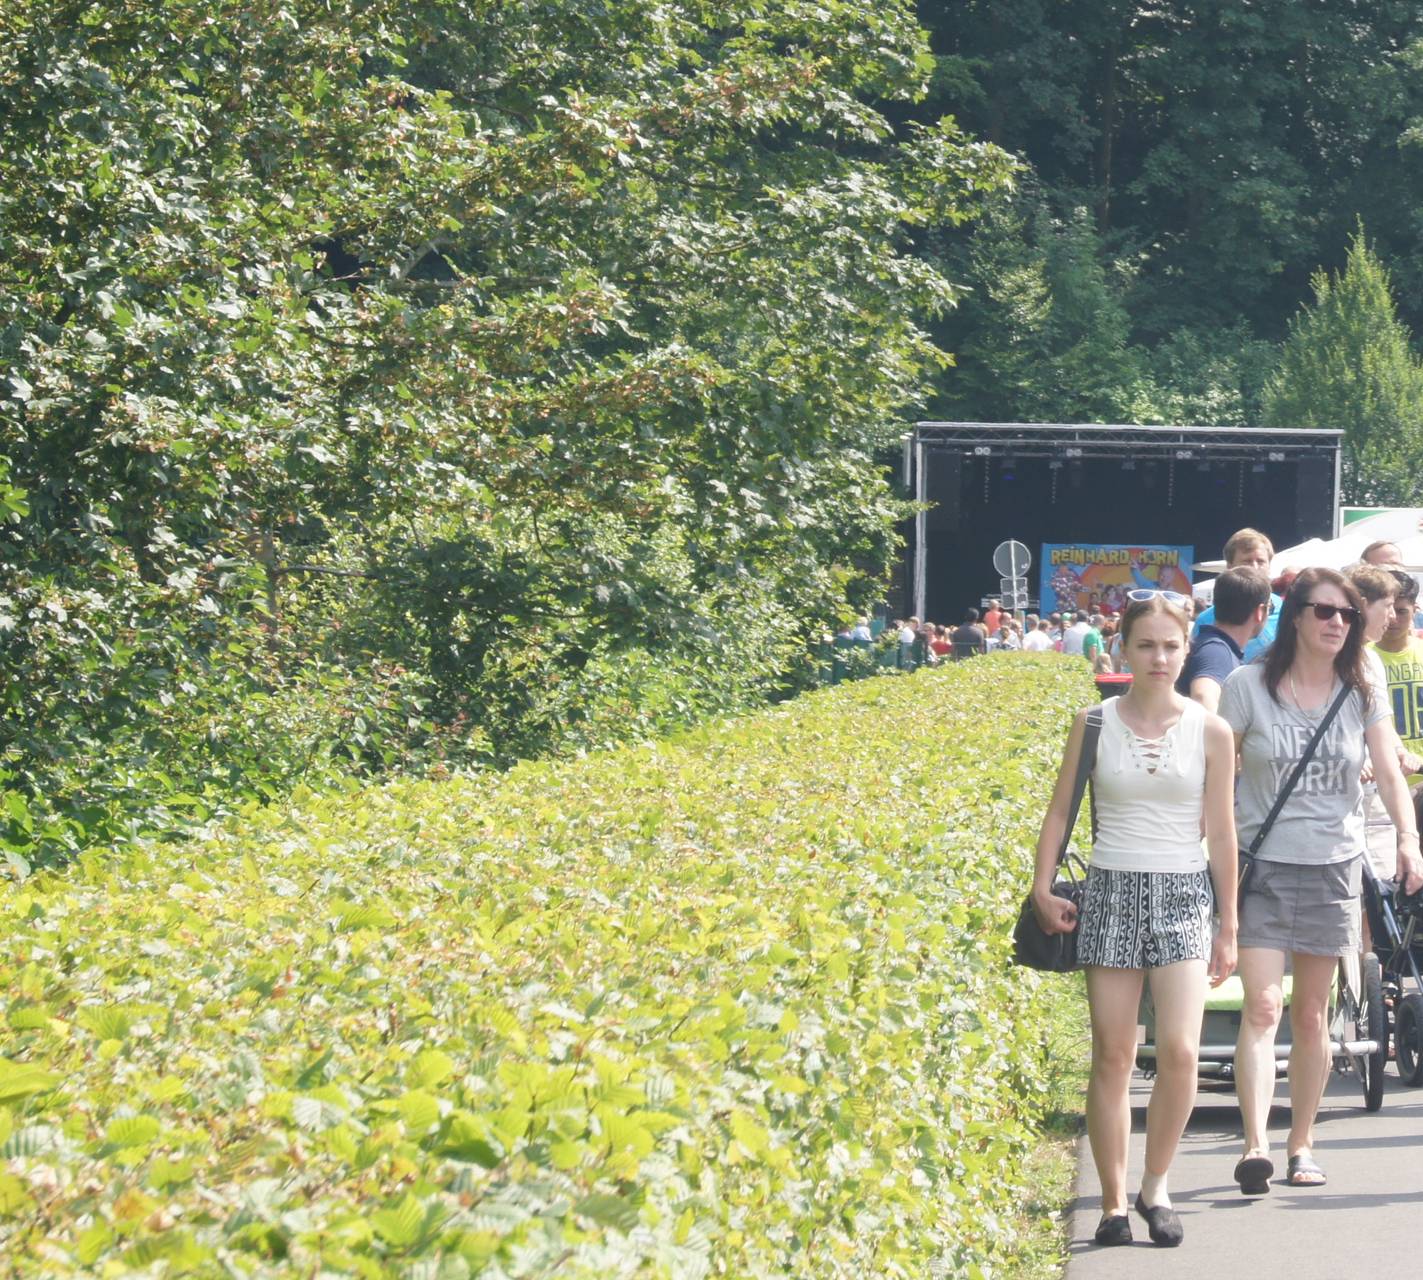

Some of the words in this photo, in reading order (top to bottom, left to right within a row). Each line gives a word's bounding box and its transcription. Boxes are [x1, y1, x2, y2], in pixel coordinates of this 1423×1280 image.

[1052, 546, 1130, 565] REINHARD
[1138, 549, 1178, 566] HORN
[1271, 722, 1341, 759] NEW
